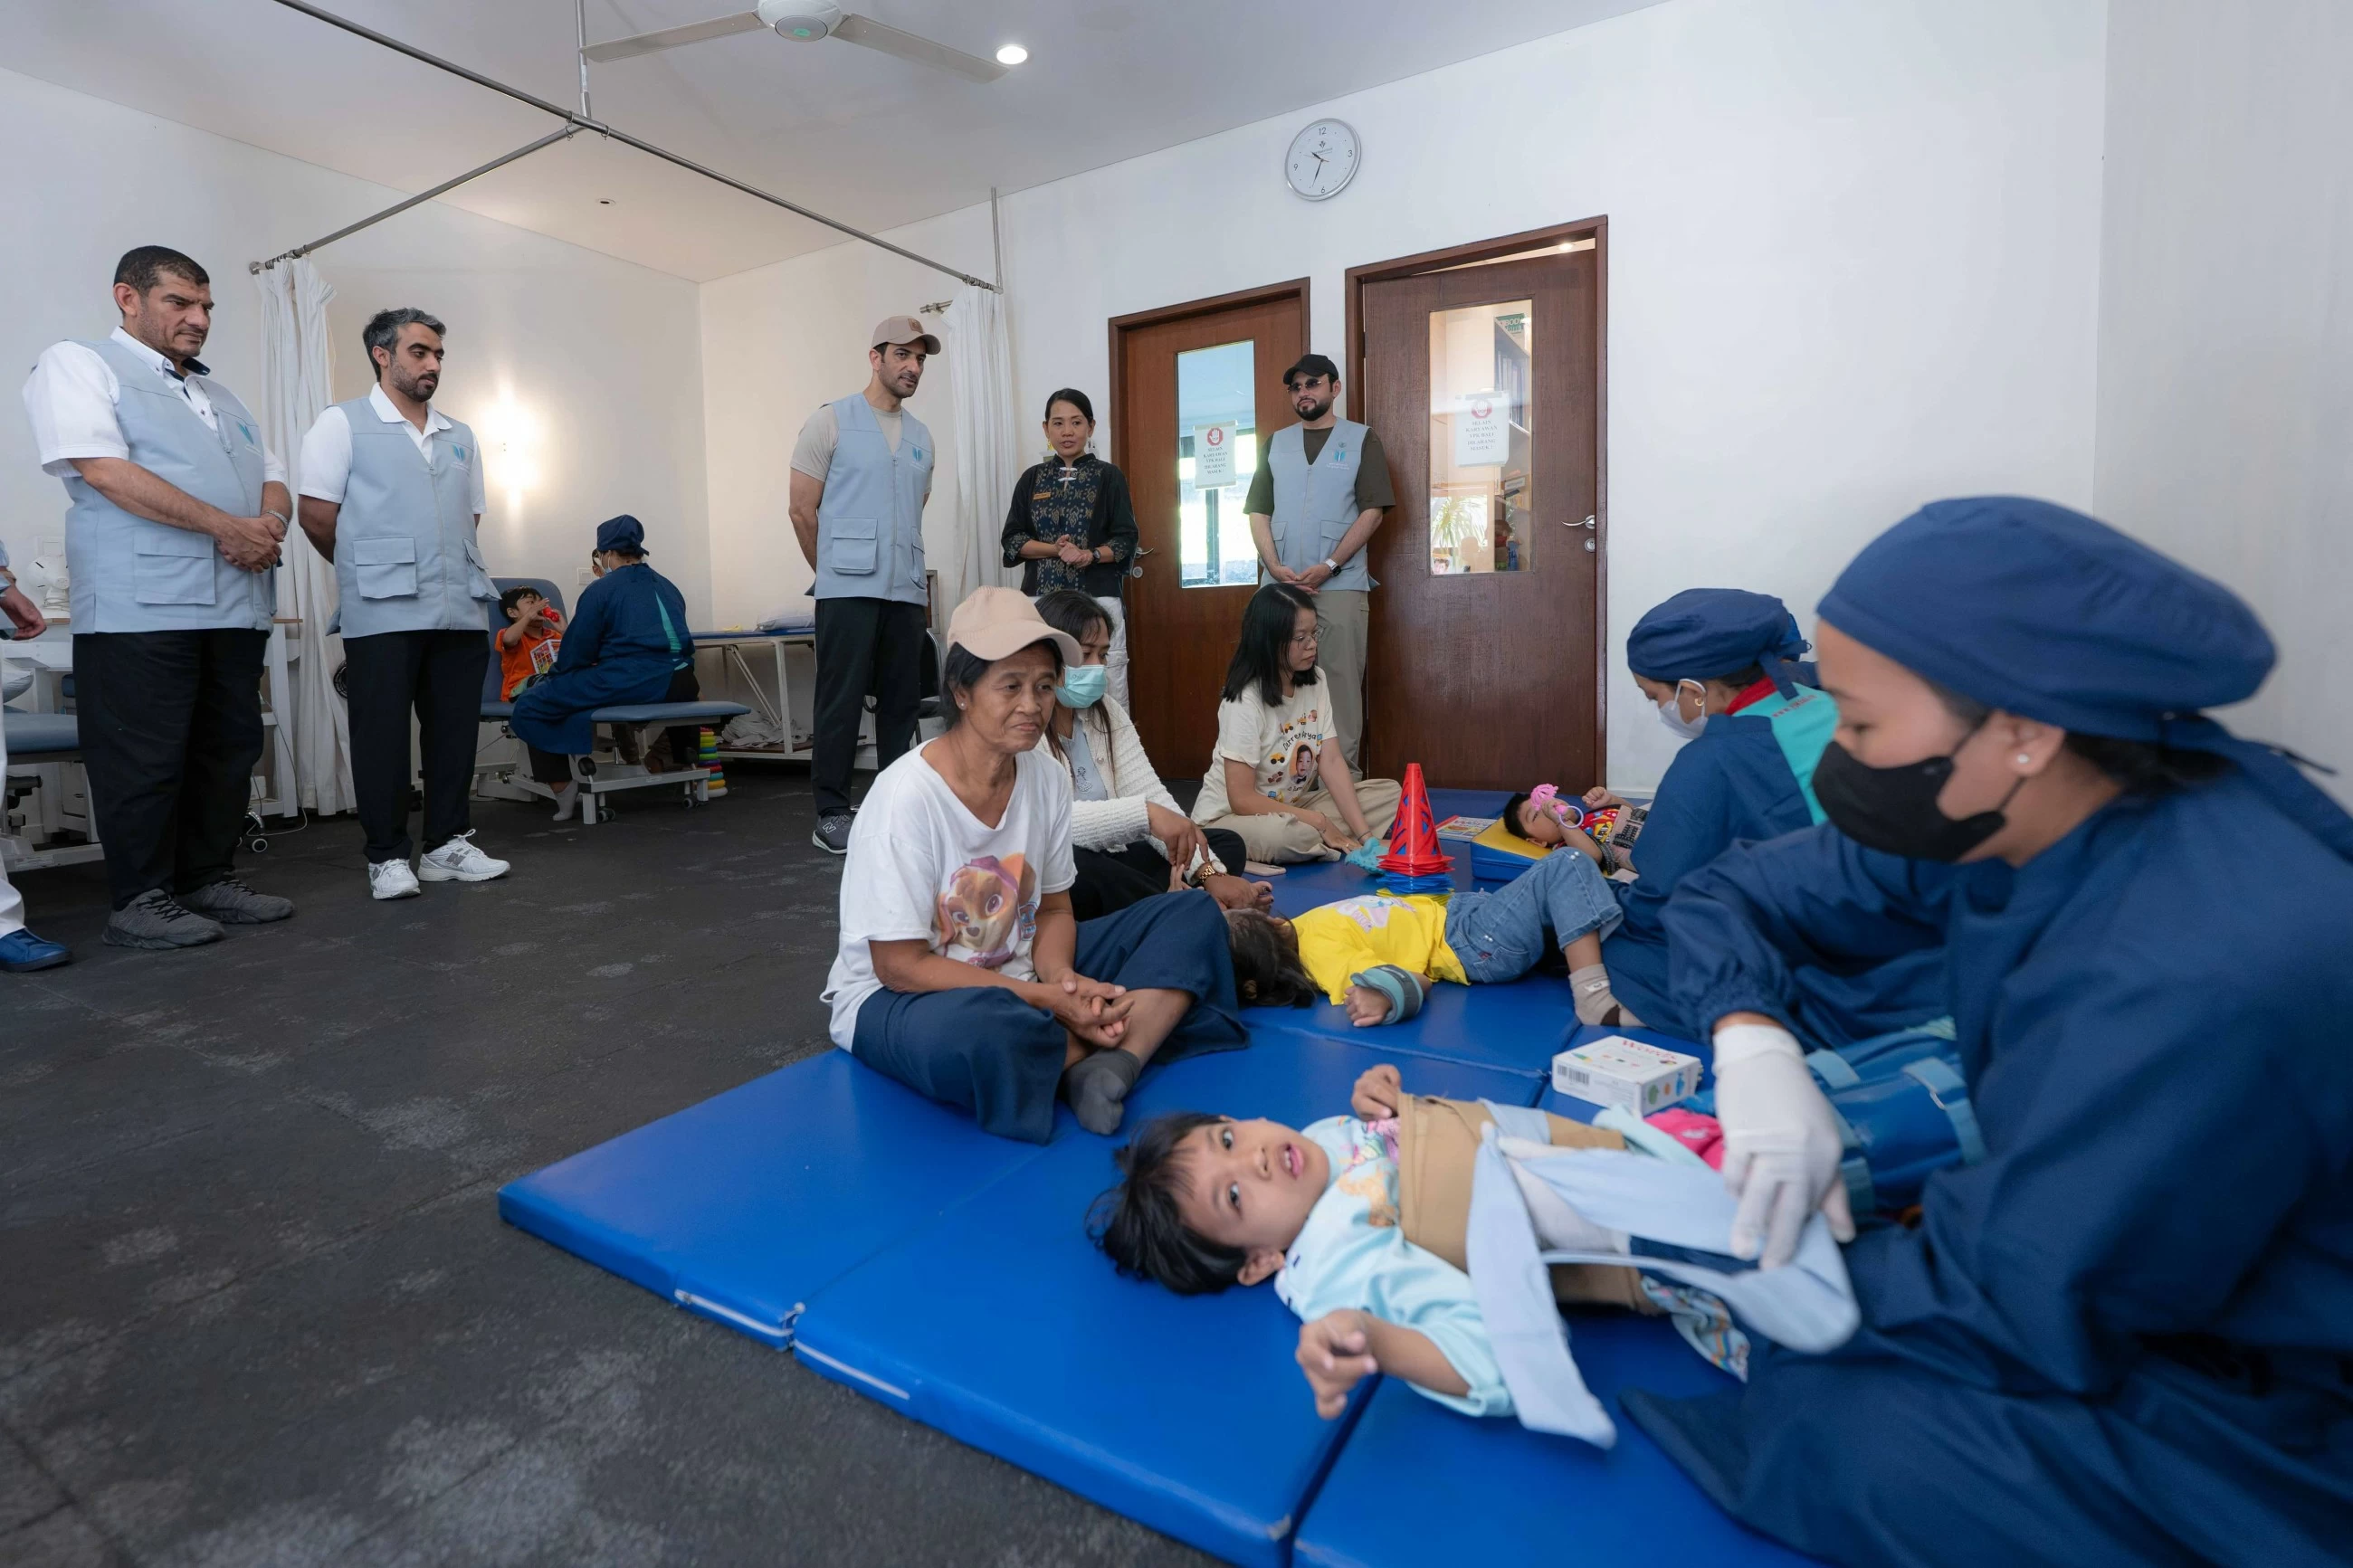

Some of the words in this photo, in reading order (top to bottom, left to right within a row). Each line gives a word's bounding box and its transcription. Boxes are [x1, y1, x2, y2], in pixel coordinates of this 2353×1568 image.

[1319, 127, 1327, 135] 12
[1348, 149, 1353, 157] 3
[1293, 163, 1299, 171] 9
[1320, 185, 1326, 194] 6
